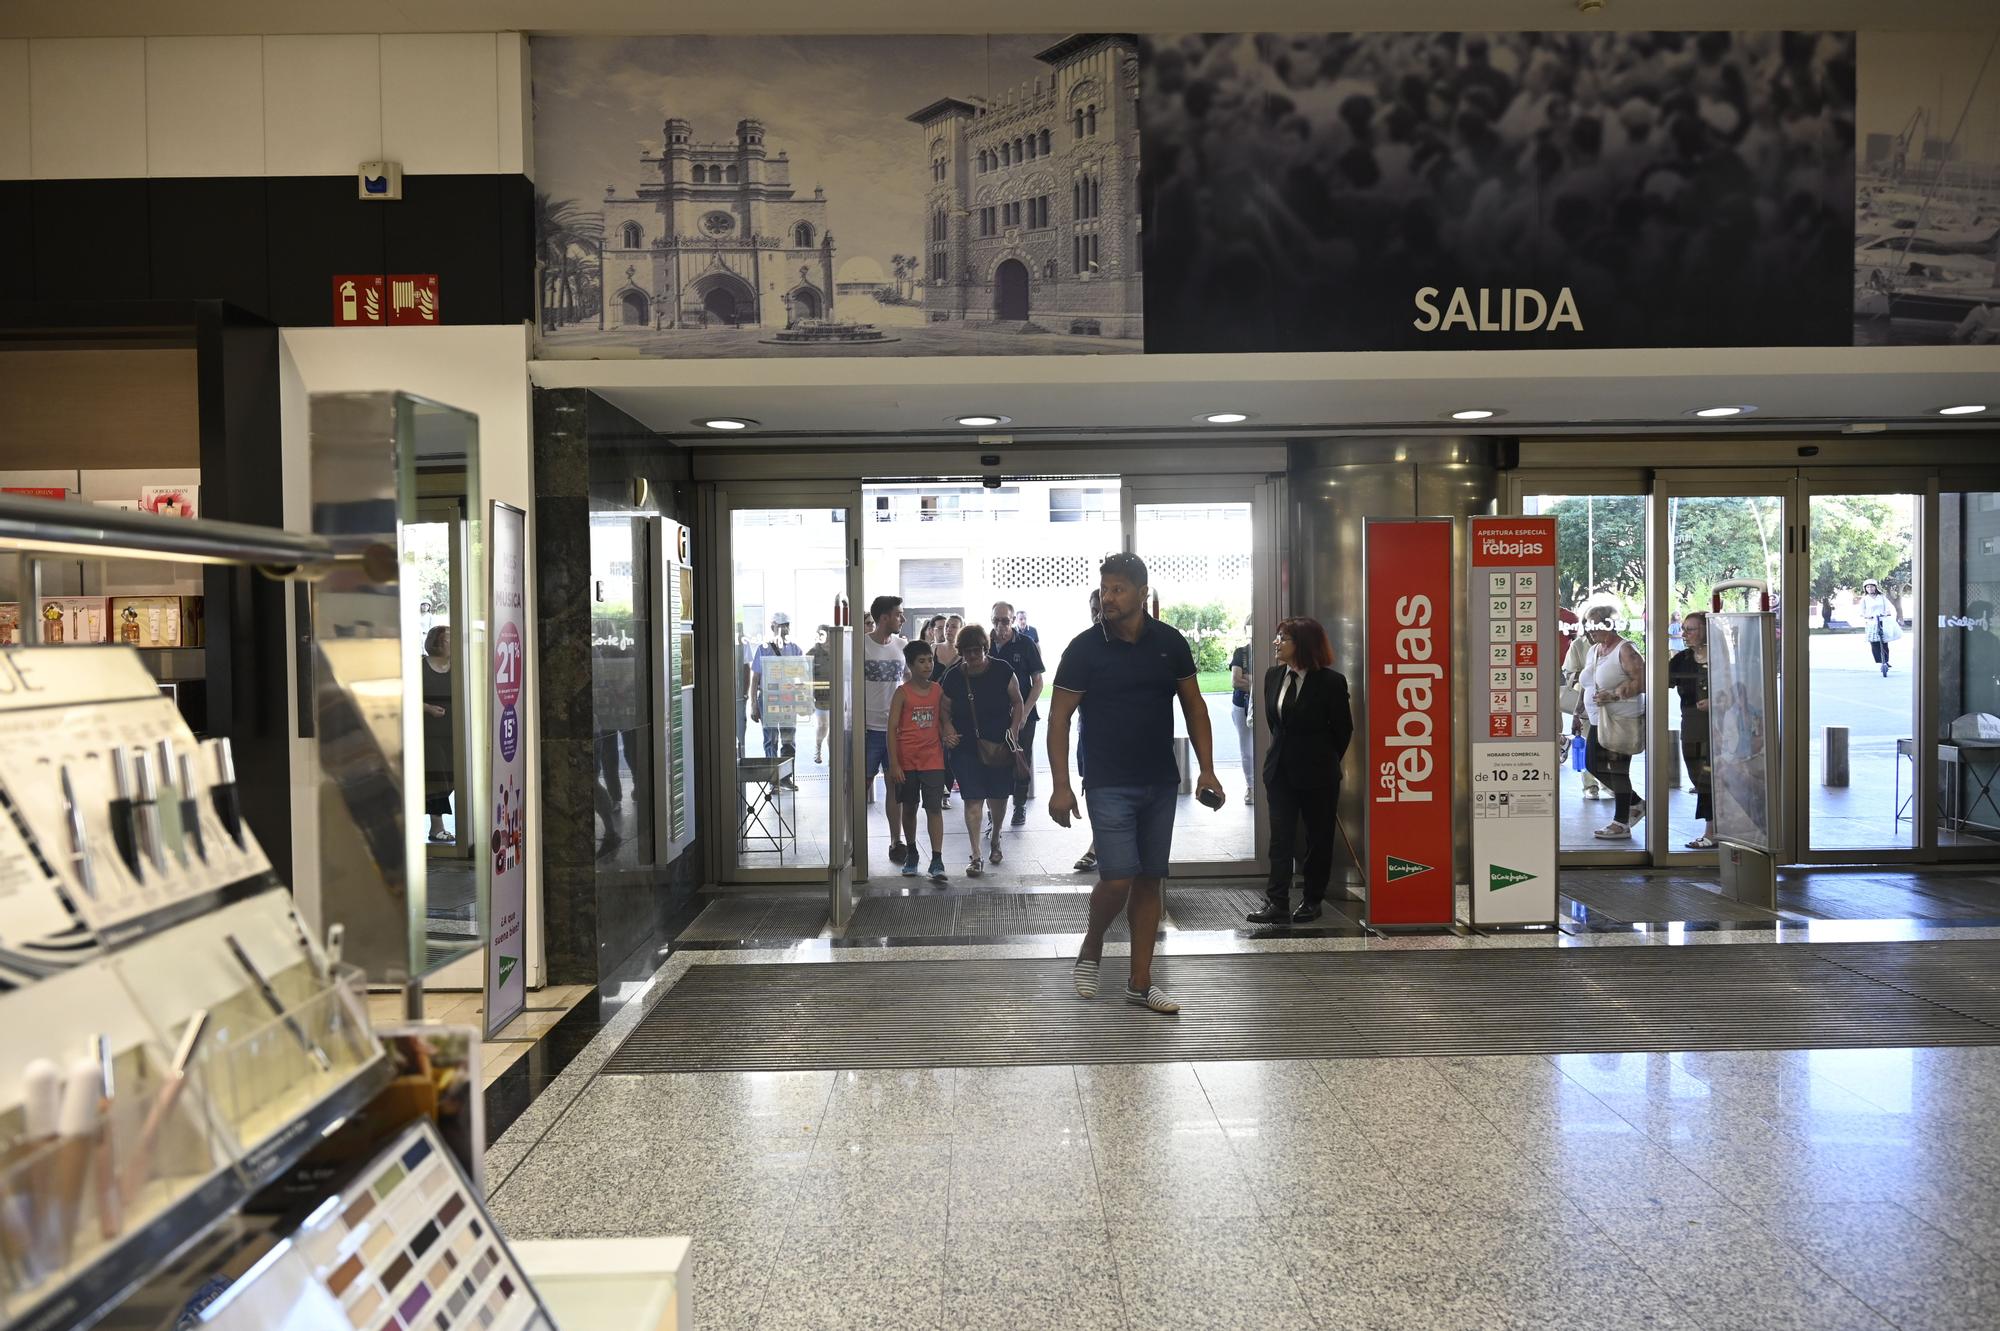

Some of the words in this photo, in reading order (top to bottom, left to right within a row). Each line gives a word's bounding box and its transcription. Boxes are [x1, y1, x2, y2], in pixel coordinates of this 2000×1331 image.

[1413, 286, 1584, 334] SALIDA
[1482, 540, 1543, 558] rebajas
[1494, 577, 1506, 586] 19
[1519, 577, 1532, 586] 26
[496, 588, 521, 608] MÚSICA
[1493, 601, 1507, 610] 20
[1519, 601, 1532, 610] 27
[1495, 625, 1506, 634] 21
[1520, 625, 1533, 633] 28
[1494, 648, 1507, 657] 22
[1519, 647, 1533, 656] 29
[1494, 672, 1507, 681] 23
[1519, 672, 1533, 681] 30
[1384, 594, 1443, 803] rebajas
[1494, 695, 1507, 704] 24
[1524, 695, 1529, 704] 1
[1494, 718, 1507, 727] 25
[1523, 718, 1530, 727] 2
[1475, 772, 1489, 782] de
[1492, 769, 1508, 781] 10
[1522, 769, 1539, 781] 22
[1543, 771, 1553, 781] h.
[1376, 761, 1396, 803] Las
[1509, 872, 1528, 882] Inglés
[494, 930, 509, 946] suena
[509, 921, 520, 938] bien?
